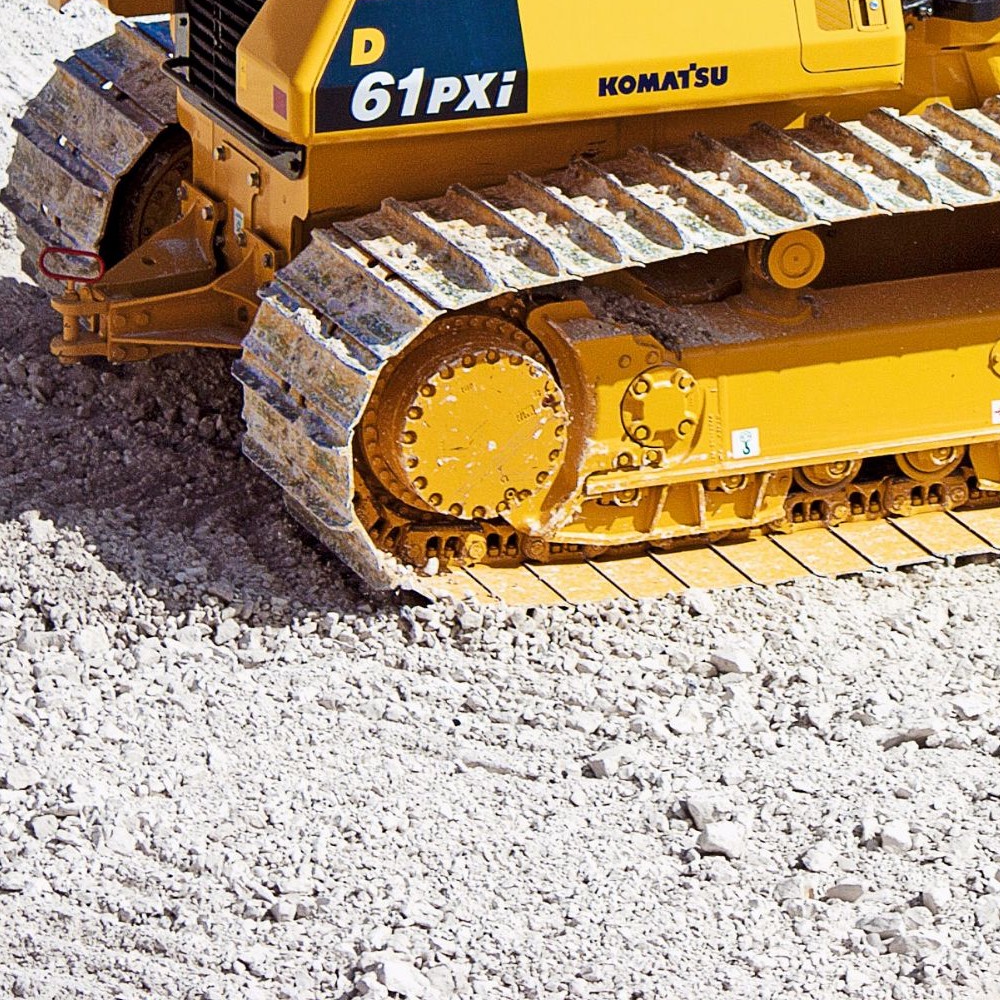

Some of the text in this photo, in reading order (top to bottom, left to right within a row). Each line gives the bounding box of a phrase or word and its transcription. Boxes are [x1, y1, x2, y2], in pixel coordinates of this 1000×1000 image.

[350, 27, 386, 66] D
[350, 67, 517, 122] 61PXi
[598, 63, 728, 97] KOMATSU
